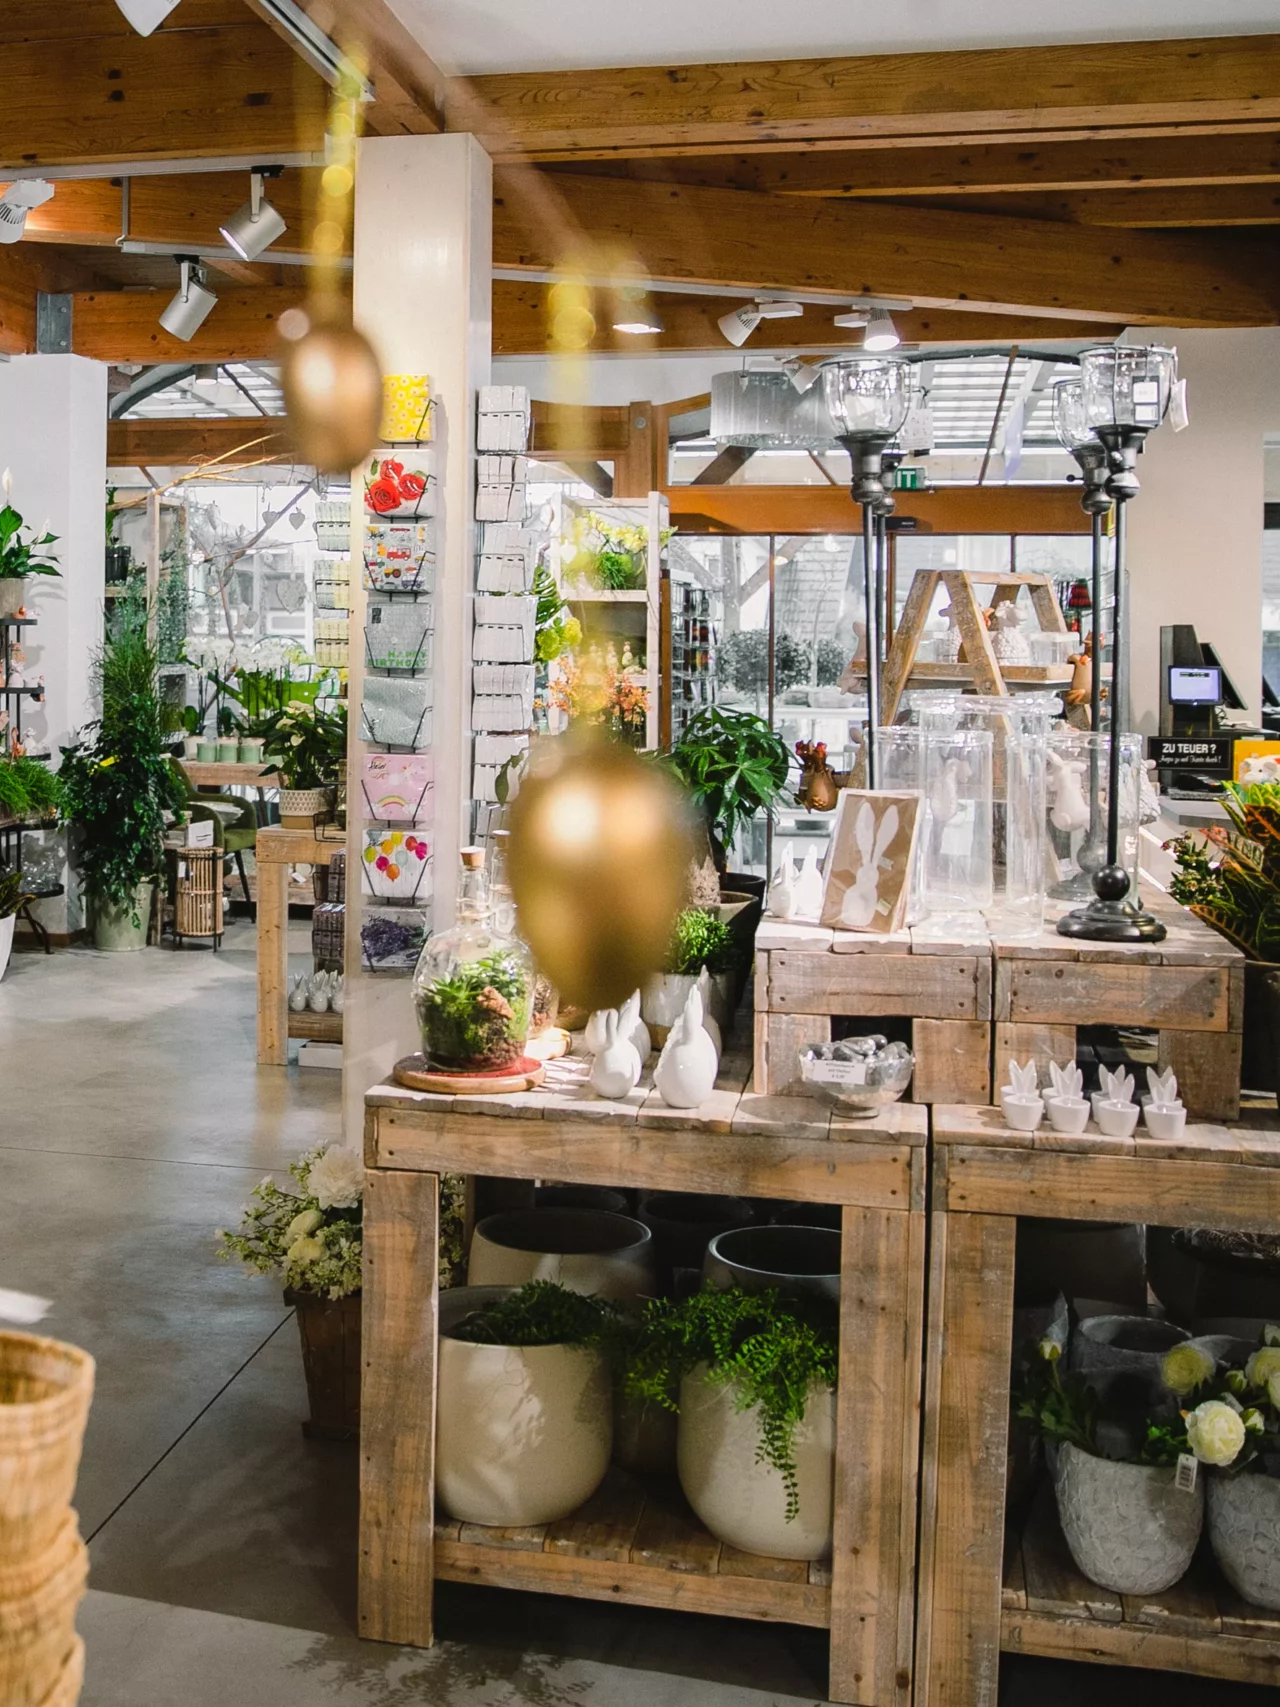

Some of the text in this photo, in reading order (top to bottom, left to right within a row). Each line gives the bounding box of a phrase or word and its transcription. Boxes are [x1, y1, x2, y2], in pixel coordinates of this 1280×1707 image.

[896, 470, 916, 488] IT
[1162, 743, 1217, 754] ZU TEUER ?
